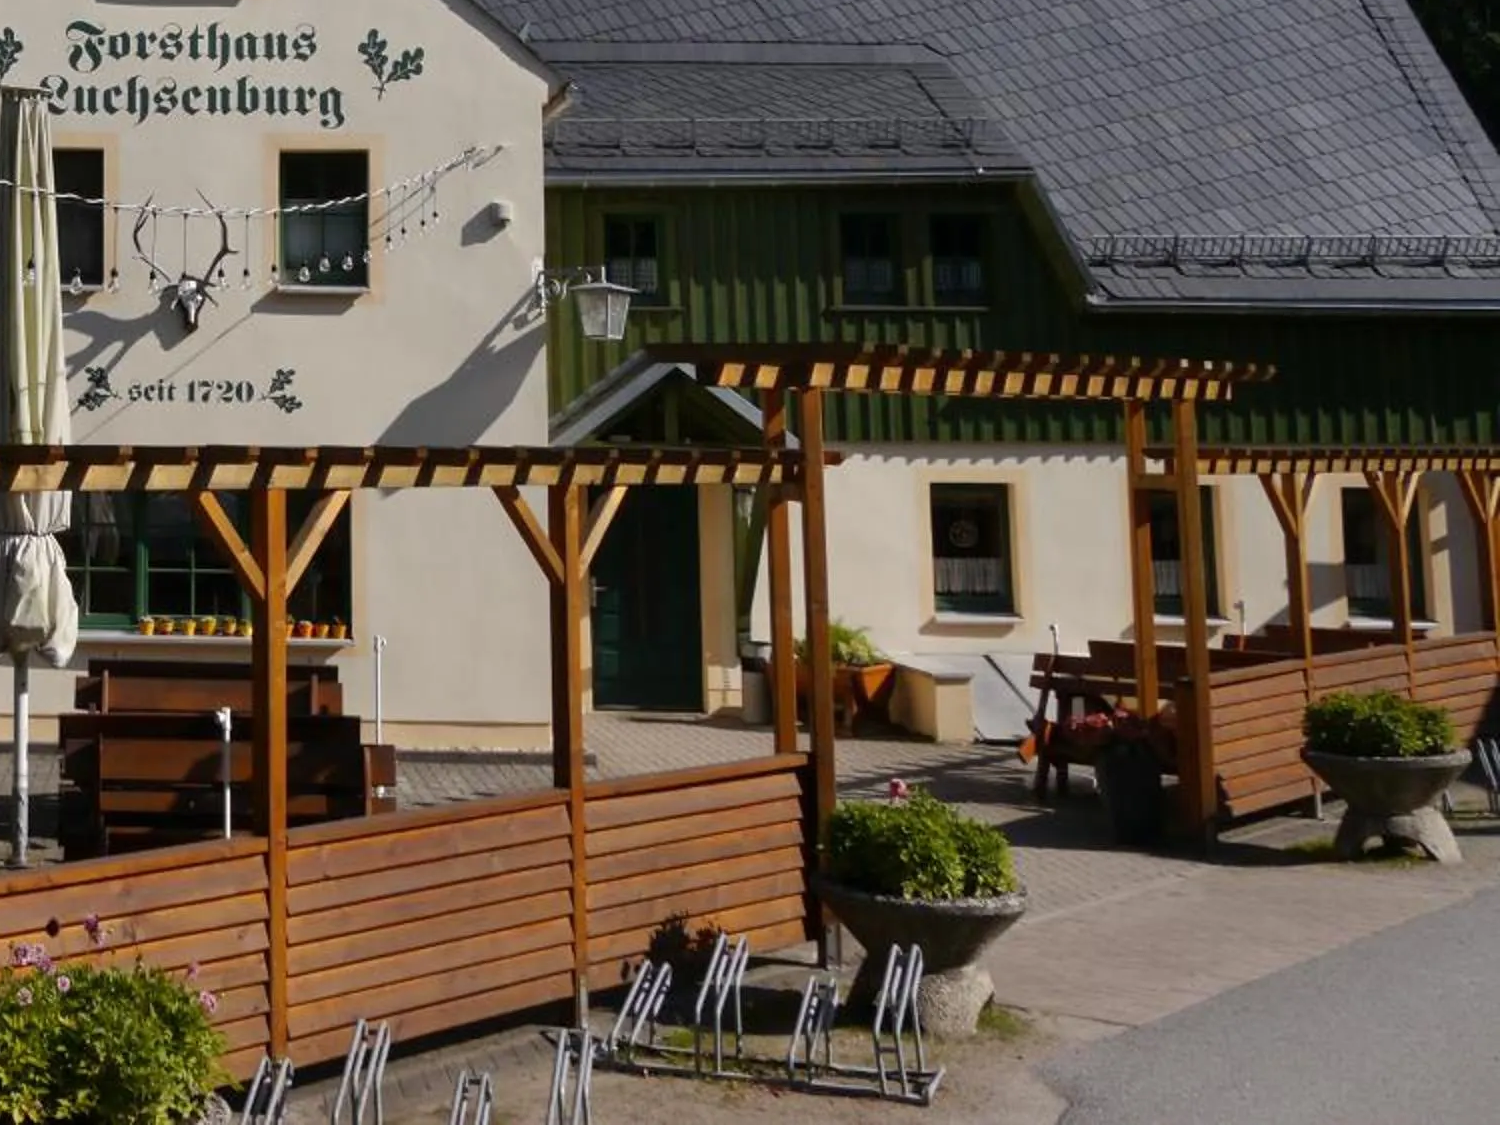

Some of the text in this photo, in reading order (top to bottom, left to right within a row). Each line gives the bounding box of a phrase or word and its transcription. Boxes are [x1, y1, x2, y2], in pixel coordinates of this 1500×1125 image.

[66, 20, 318, 73] Forsthaus
[40, 75, 344, 129] Luchsenburg
[127, 379, 254, 403] seit 1720
